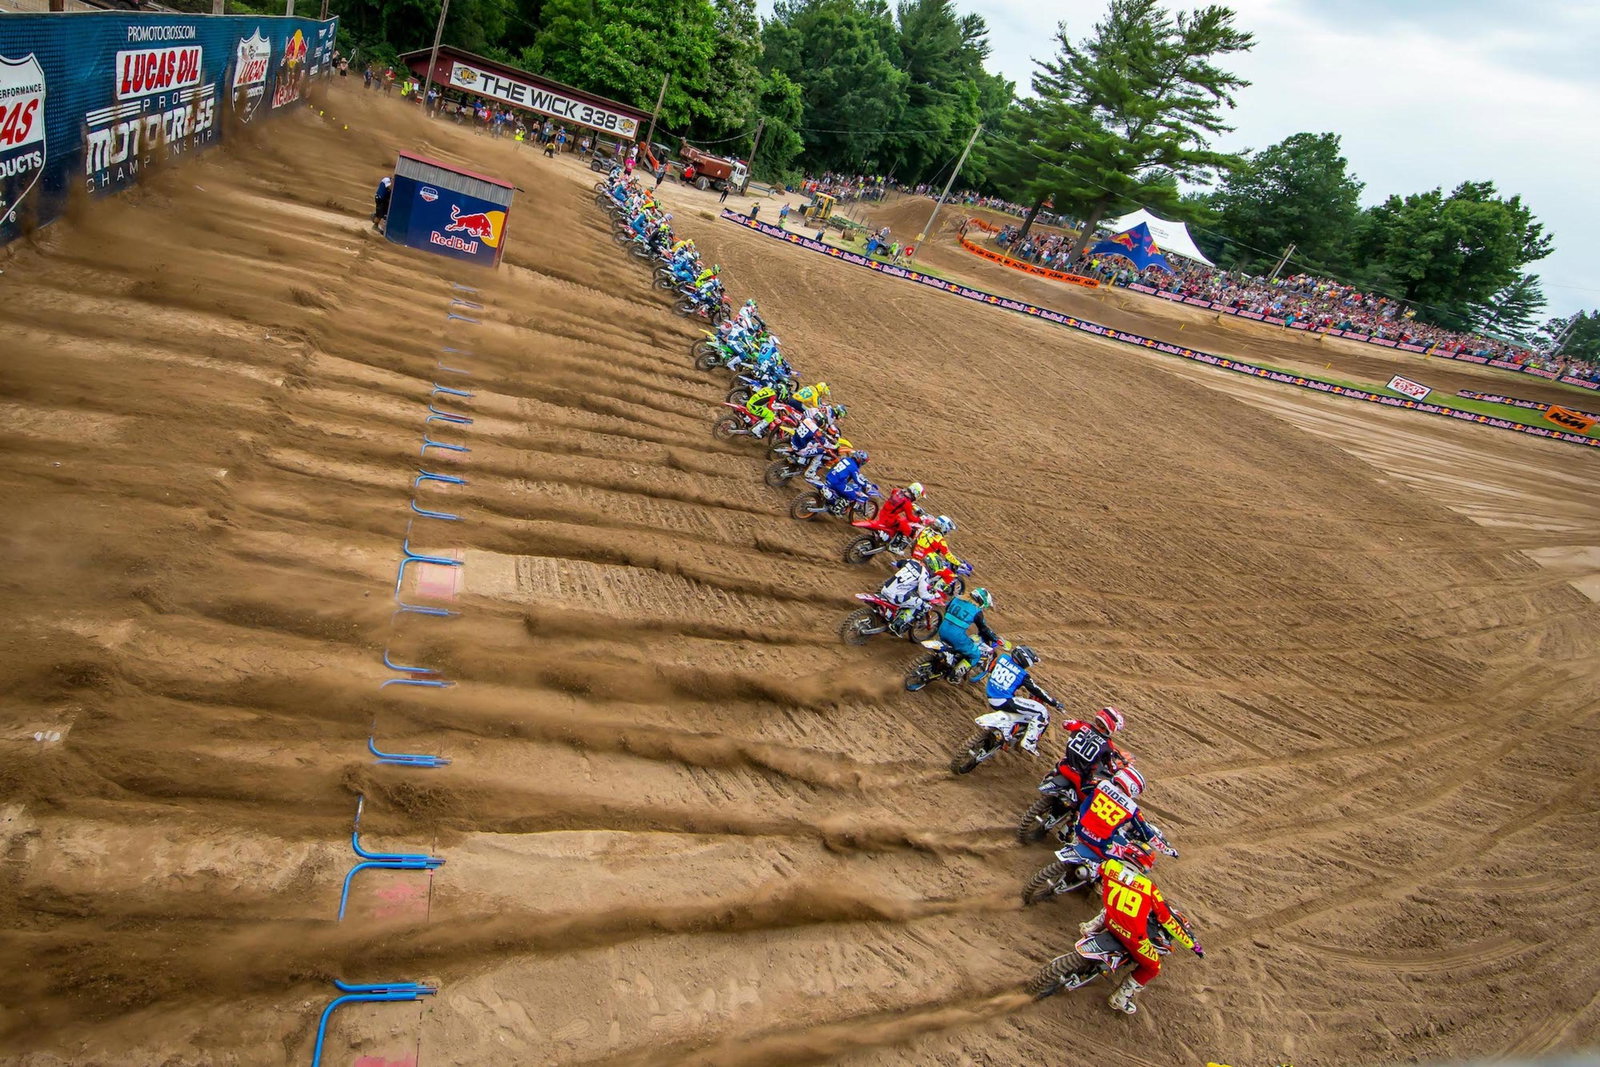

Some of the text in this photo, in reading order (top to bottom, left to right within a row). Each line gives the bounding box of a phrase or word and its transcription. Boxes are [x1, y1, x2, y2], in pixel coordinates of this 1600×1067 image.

[121, 49, 199, 94] LUCAS OIL
[143, 92, 179, 111] PRO
[479, 73, 617, 130] THE WICK 338
[86, 98, 215, 176] MOTOCROSS
[86, 130, 212, 193] CHAMPNSHIP
[1549, 412, 1587, 430] KTM
[1090, 792, 1127, 826] 583
[1101, 785, 1130, 811] RIDEL
[1107, 879, 1143, 918] 719
